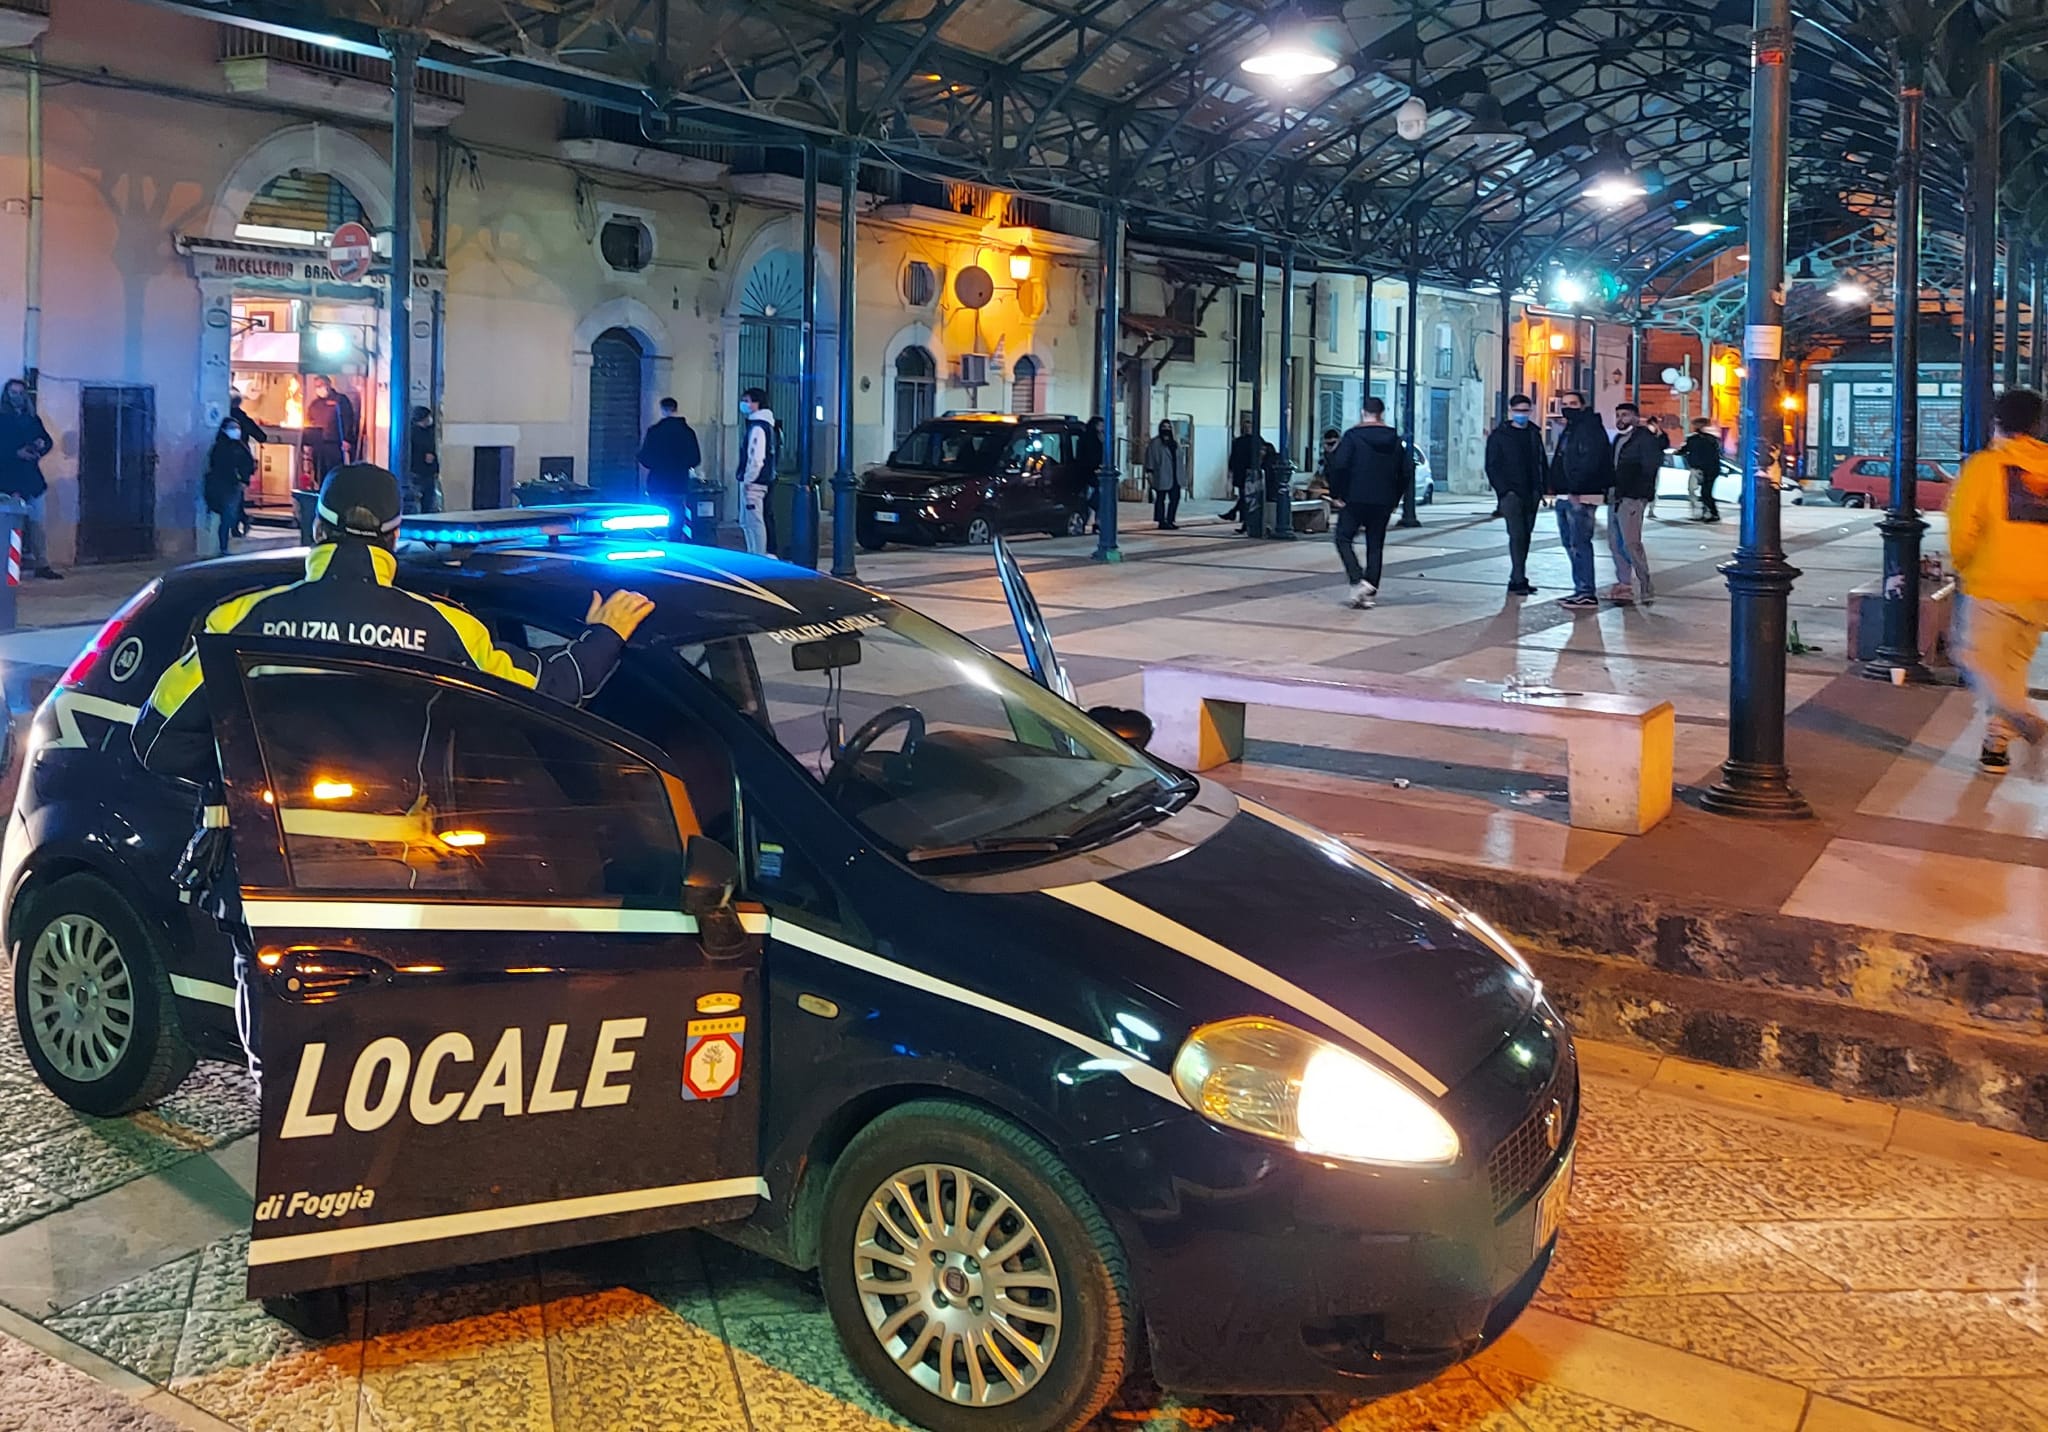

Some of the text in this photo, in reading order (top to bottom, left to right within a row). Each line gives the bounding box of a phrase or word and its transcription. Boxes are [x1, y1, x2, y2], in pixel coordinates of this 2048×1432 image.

[215, 256, 294, 277] MACELLERIA
[262, 621, 427, 652] POLIZIA LOCALE
[767, 613, 887, 645] POLIZIA LOCALE
[279, 1017, 648, 1139] LOCALE
[255, 1184, 375, 1221] di Foggia
